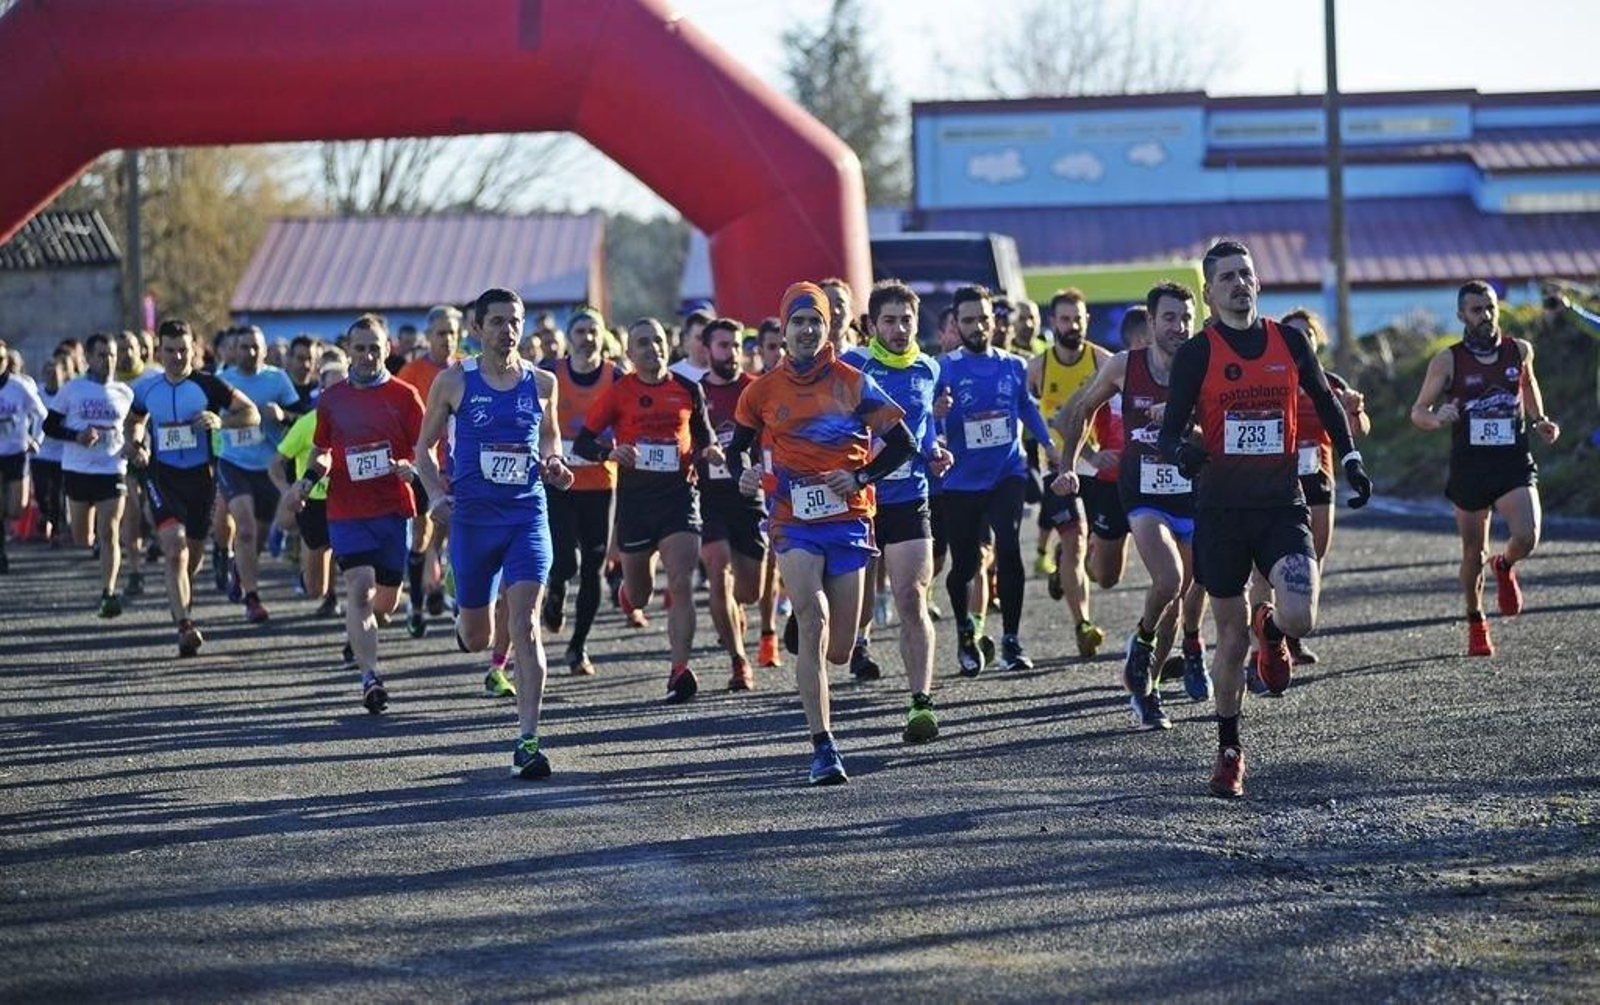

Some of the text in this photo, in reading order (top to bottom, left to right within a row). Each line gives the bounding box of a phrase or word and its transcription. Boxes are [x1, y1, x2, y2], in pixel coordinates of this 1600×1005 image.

[980, 424, 993, 438] 18
[1238, 426, 1266, 443] 233
[1484, 423, 1498, 436] 63
[356, 454, 378, 471] 257
[649, 449, 665, 462] 119
[492, 456, 516, 472] 272
[1156, 468, 1173, 483] 55
[807, 489, 826, 507] 50
